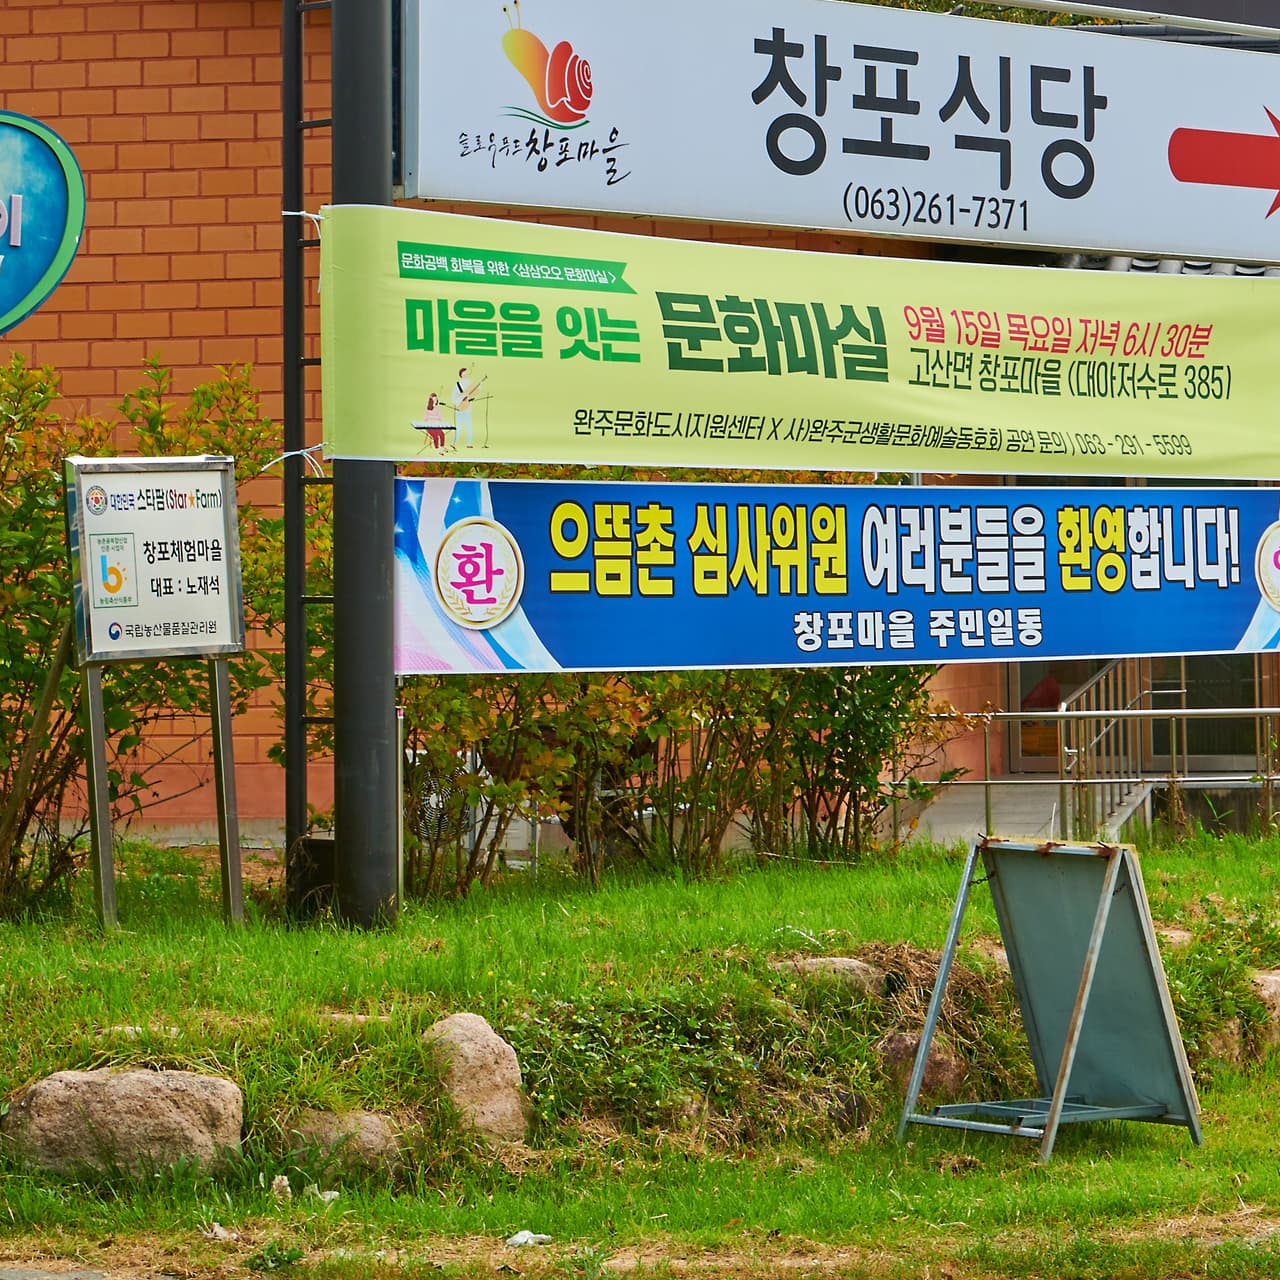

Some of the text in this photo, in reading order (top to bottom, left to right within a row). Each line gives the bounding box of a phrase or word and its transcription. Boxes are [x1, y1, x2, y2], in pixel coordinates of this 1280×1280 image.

[751, 27, 1108, 200] 창포식당
[450, 257, 486, 275] 회복을
[487, 261, 510, 277] 위한
[405, 291, 889, 383] 마을을 잇는 문화마실
[903, 304, 1214, 359] 9월 15일 목요일 저녁 6시 30분
[908, 347, 973, 391] 고산면
[979, 353, 1062, 397] 창포마을
[1184, 364, 1232, 400] 385)
[573, 408, 766, 441] 완주문화도시지원센터
[766, 418, 784, 441] X
[1006, 428, 1036, 454] 공연
[1037, 430, 1067, 455] 문의
[143, 539, 222, 565] 창포체험마을
[451, 541, 505, 606] 환
[549, 500, 1241, 597] 으뜸촌 심사위원 여러분들을 환영합니다!
[150, 577, 175, 597] 대표
[186, 575, 220, 596] 노재석
[125, 620, 217, 638] 국립농산물품질관리원
[793, 607, 1044, 652] 창포마을 주민일동
